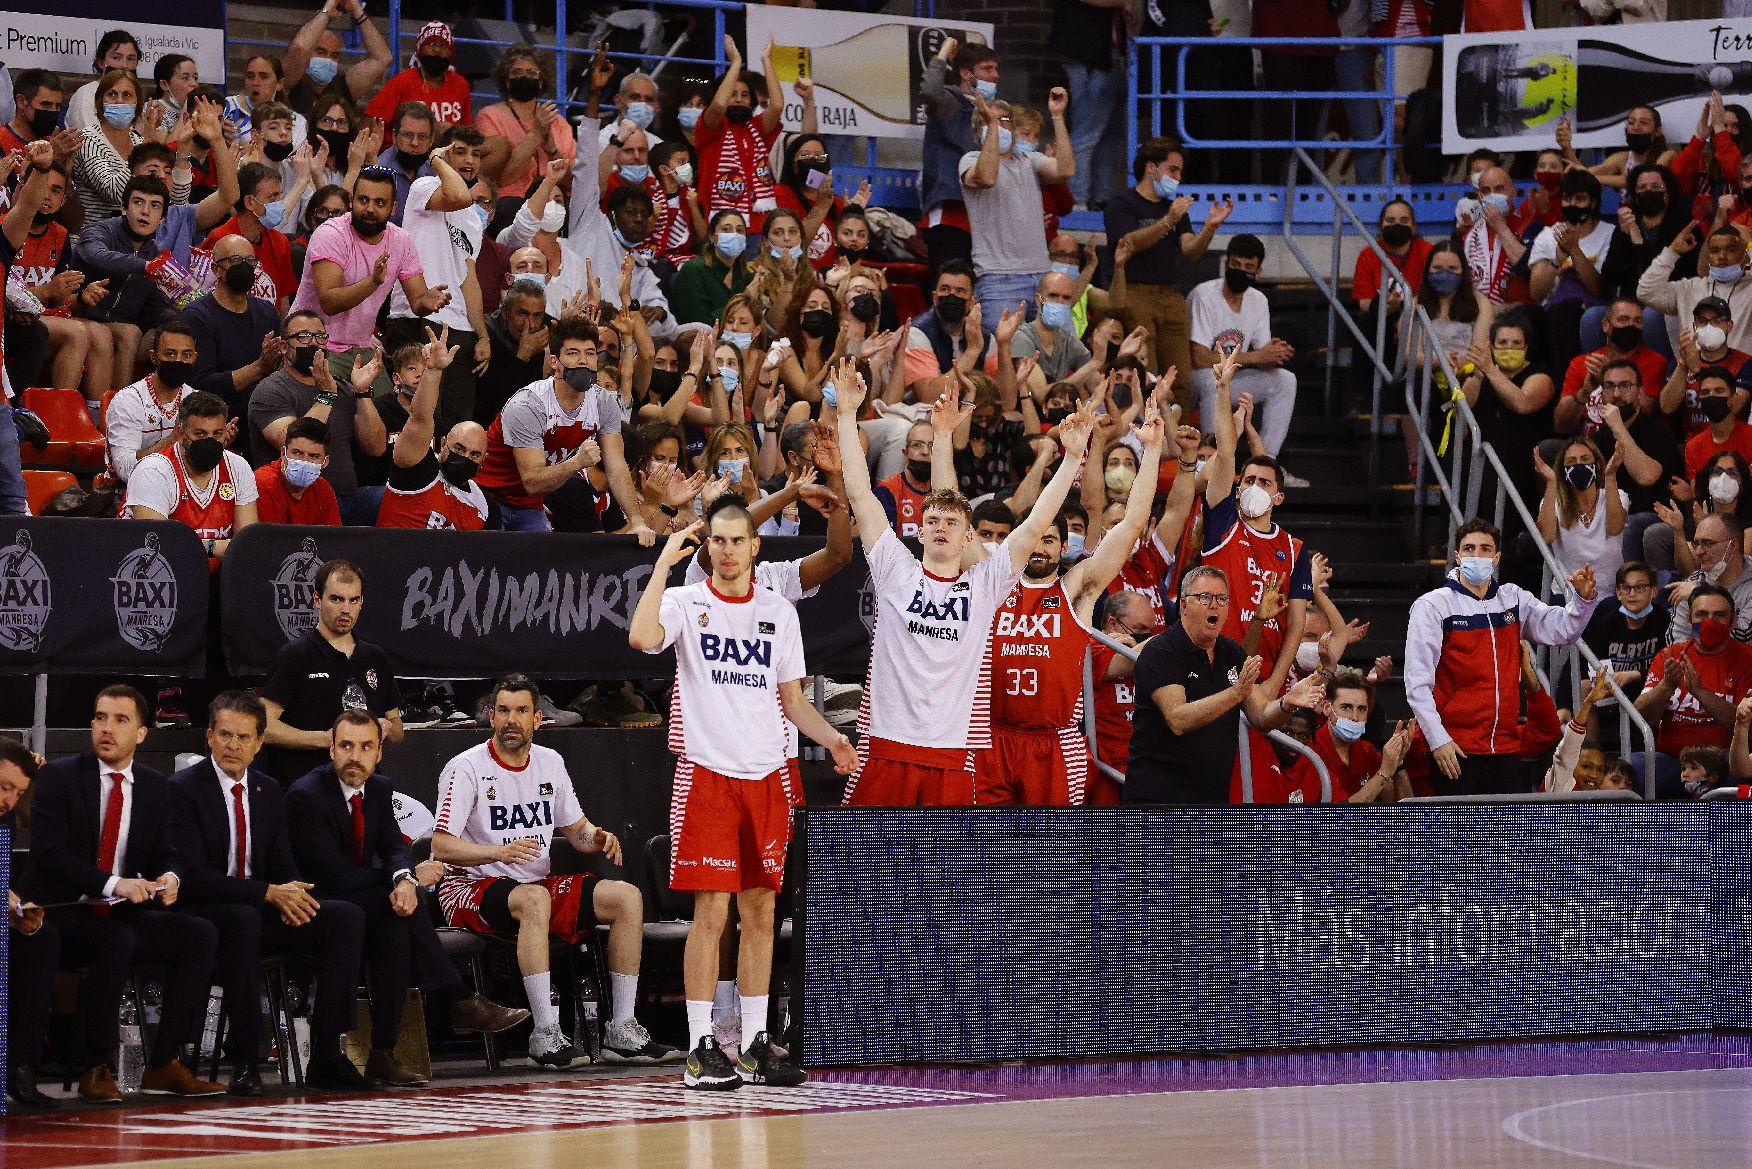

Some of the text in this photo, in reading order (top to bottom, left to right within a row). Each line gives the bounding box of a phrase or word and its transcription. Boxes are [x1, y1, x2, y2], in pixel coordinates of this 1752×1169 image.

[7, 27, 87, 56] Premium
[145, 35, 180, 49] Igualada
[185, 37, 199, 50] Vic
[823, 106, 857, 129] RAJA
[717, 180, 745, 191] BAXI
[116, 580, 176, 608] BAXI
[906, 590, 969, 621] BAXI
[126, 614, 166, 627] MANRESA
[907, 620, 960, 641] MANRESA
[996, 611, 1062, 638] BAXI
[700, 632, 772, 668] BAXI
[1000, 642, 1051, 658] MANRESA
[711, 669, 768, 689] MANRESA
[1006, 668, 1038, 696] 33
[489, 800, 553, 831] BAXI
